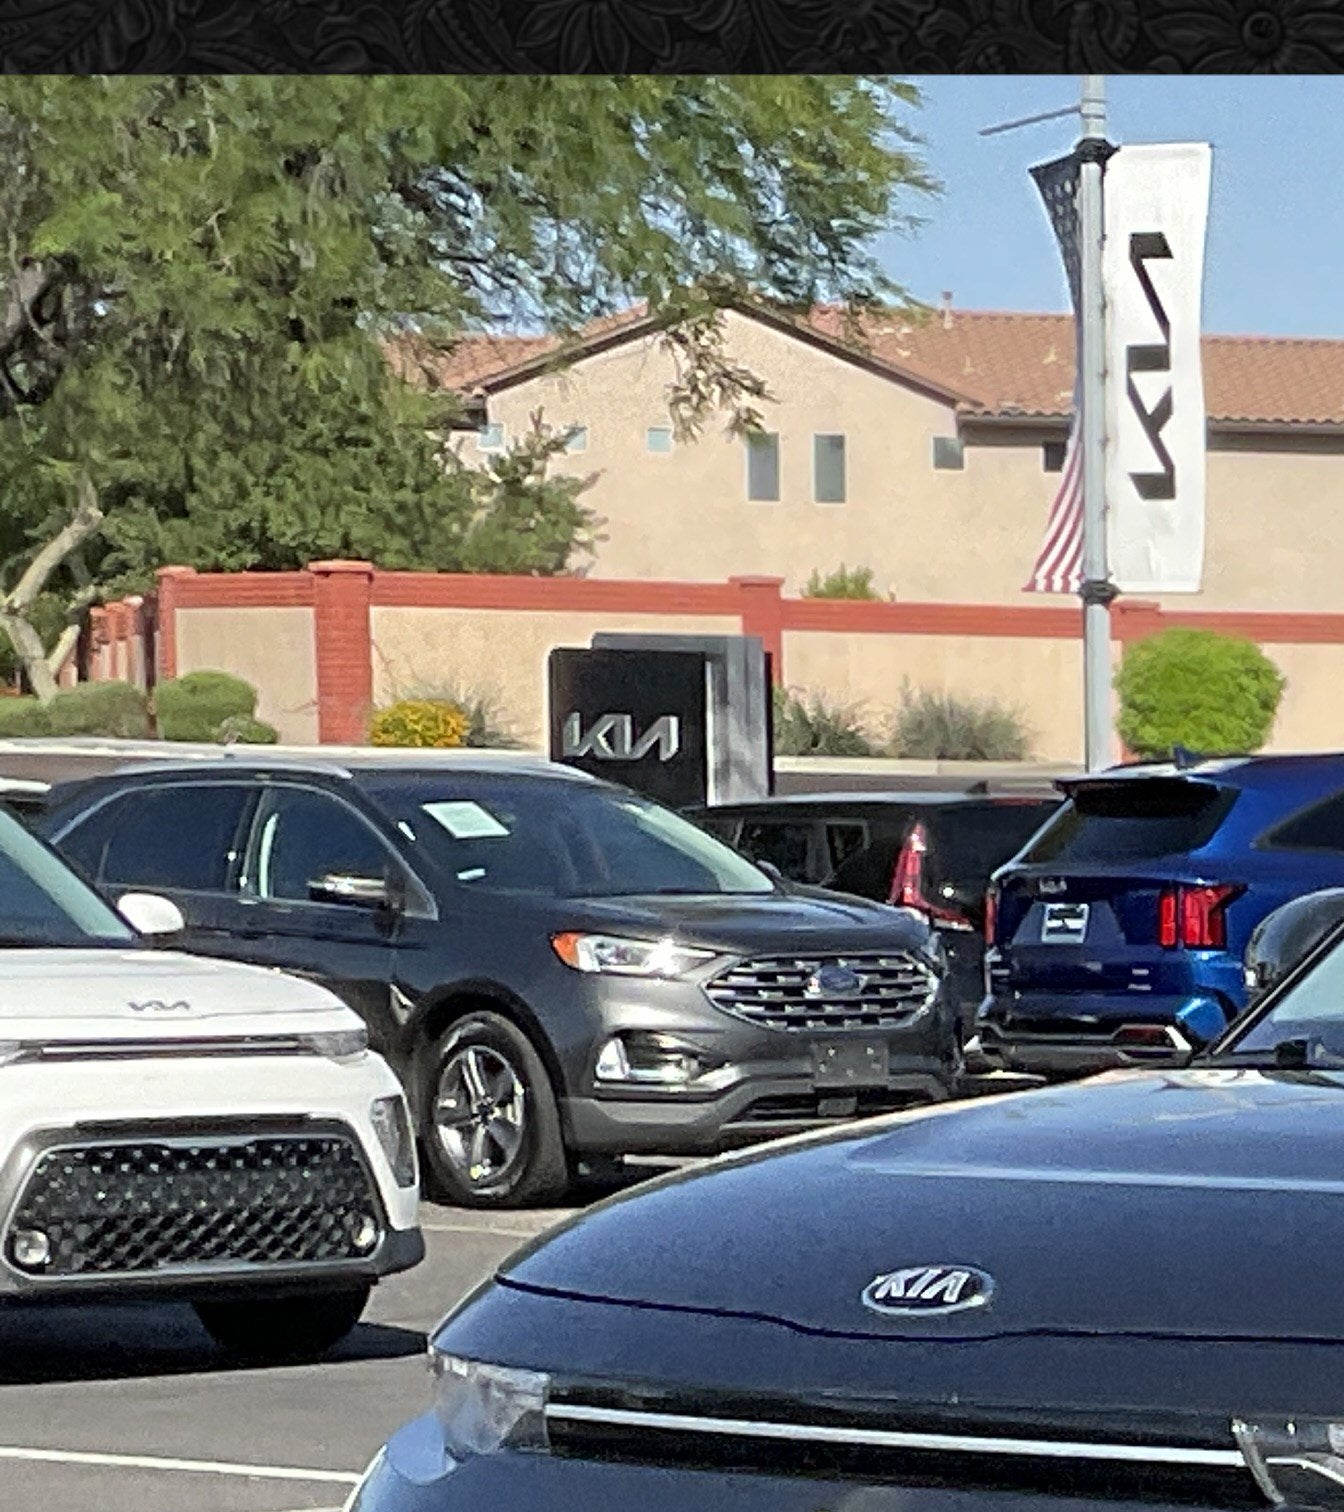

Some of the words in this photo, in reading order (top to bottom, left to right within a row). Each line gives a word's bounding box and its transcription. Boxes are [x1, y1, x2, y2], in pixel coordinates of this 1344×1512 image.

[1126, 231, 1176, 500] KIA
[562, 711, 679, 762] KIA
[873, 1267, 972, 1304] KIA
